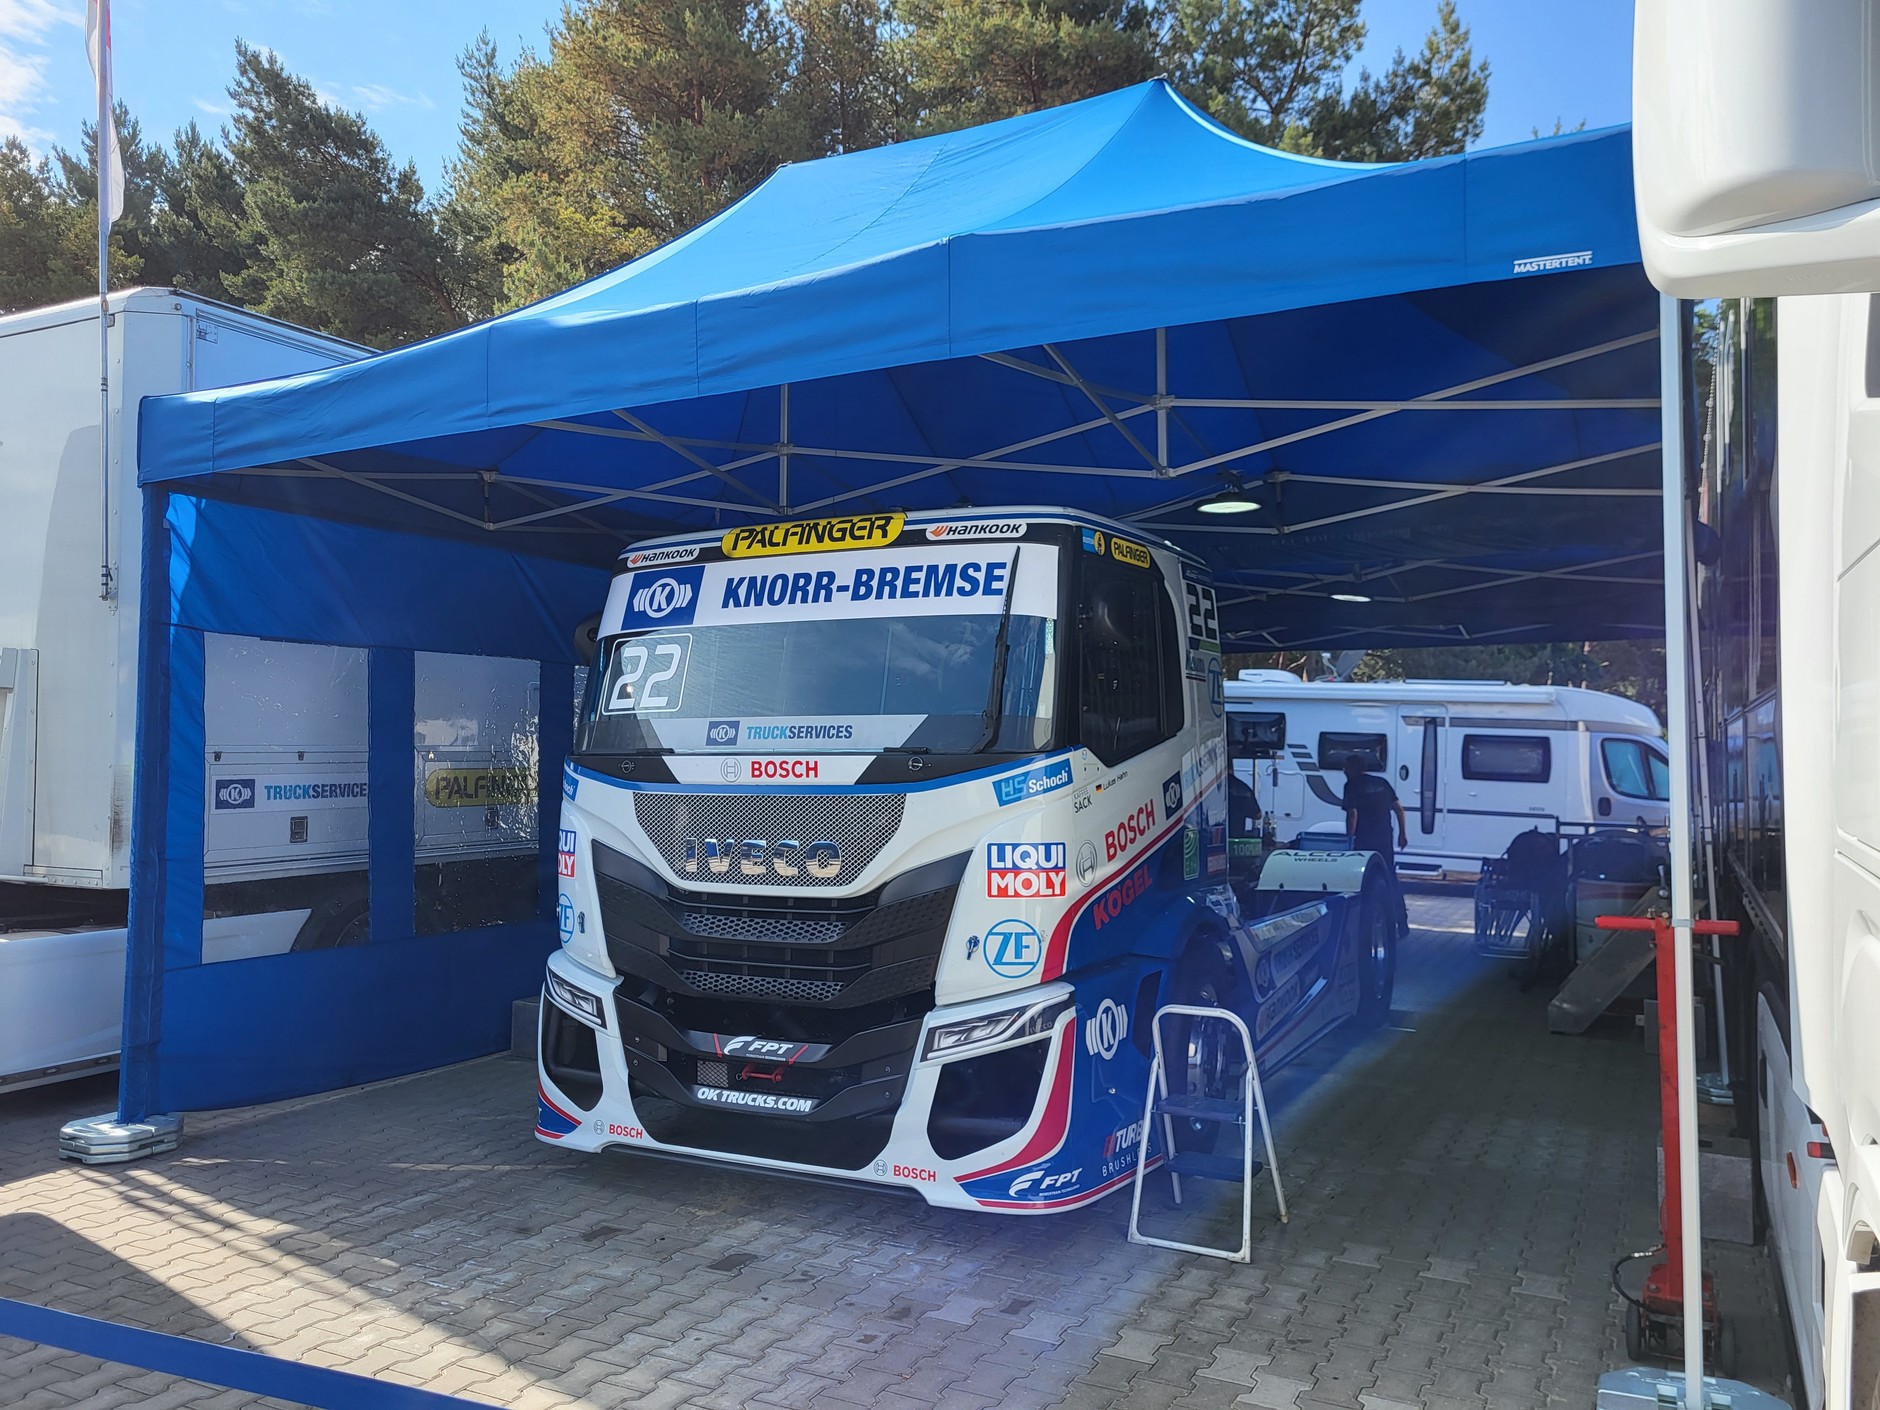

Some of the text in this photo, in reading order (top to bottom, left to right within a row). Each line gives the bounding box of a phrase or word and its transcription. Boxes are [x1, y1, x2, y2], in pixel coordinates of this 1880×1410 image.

[1513, 254, 1593, 274] MASTERTENT
[731, 516, 895, 552] PALFINGER
[1113, 541, 1149, 566] PALFINGER
[721, 562, 1008, 609] KNORR-BREMSE
[1186, 582, 1218, 641] 22
[608, 643, 682, 710] 22
[746, 725, 853, 740] TRUCKSERVICES
[751, 760, 819, 778] BOSCH
[1028, 769, 1068, 793] Schoch
[264, 783, 368, 800] TRUCKSERVICE
[1073, 795, 1093, 813] SACK
[1105, 798, 1156, 863] BOSCH
[685, 837, 843, 878] IVECO
[990, 844, 1064, 870] LIQUI
[990, 871, 1066, 896] MOLY
[747, 1041, 794, 1055] FPT
[697, 1087, 813, 1112] OK TRUCKS.COM
[609, 1123, 643, 1139] BOSCH
[1116, 1119, 1145, 1153] TURB
[893, 1165, 936, 1182] BOSCH
[1039, 1167, 1083, 1189] FPT
